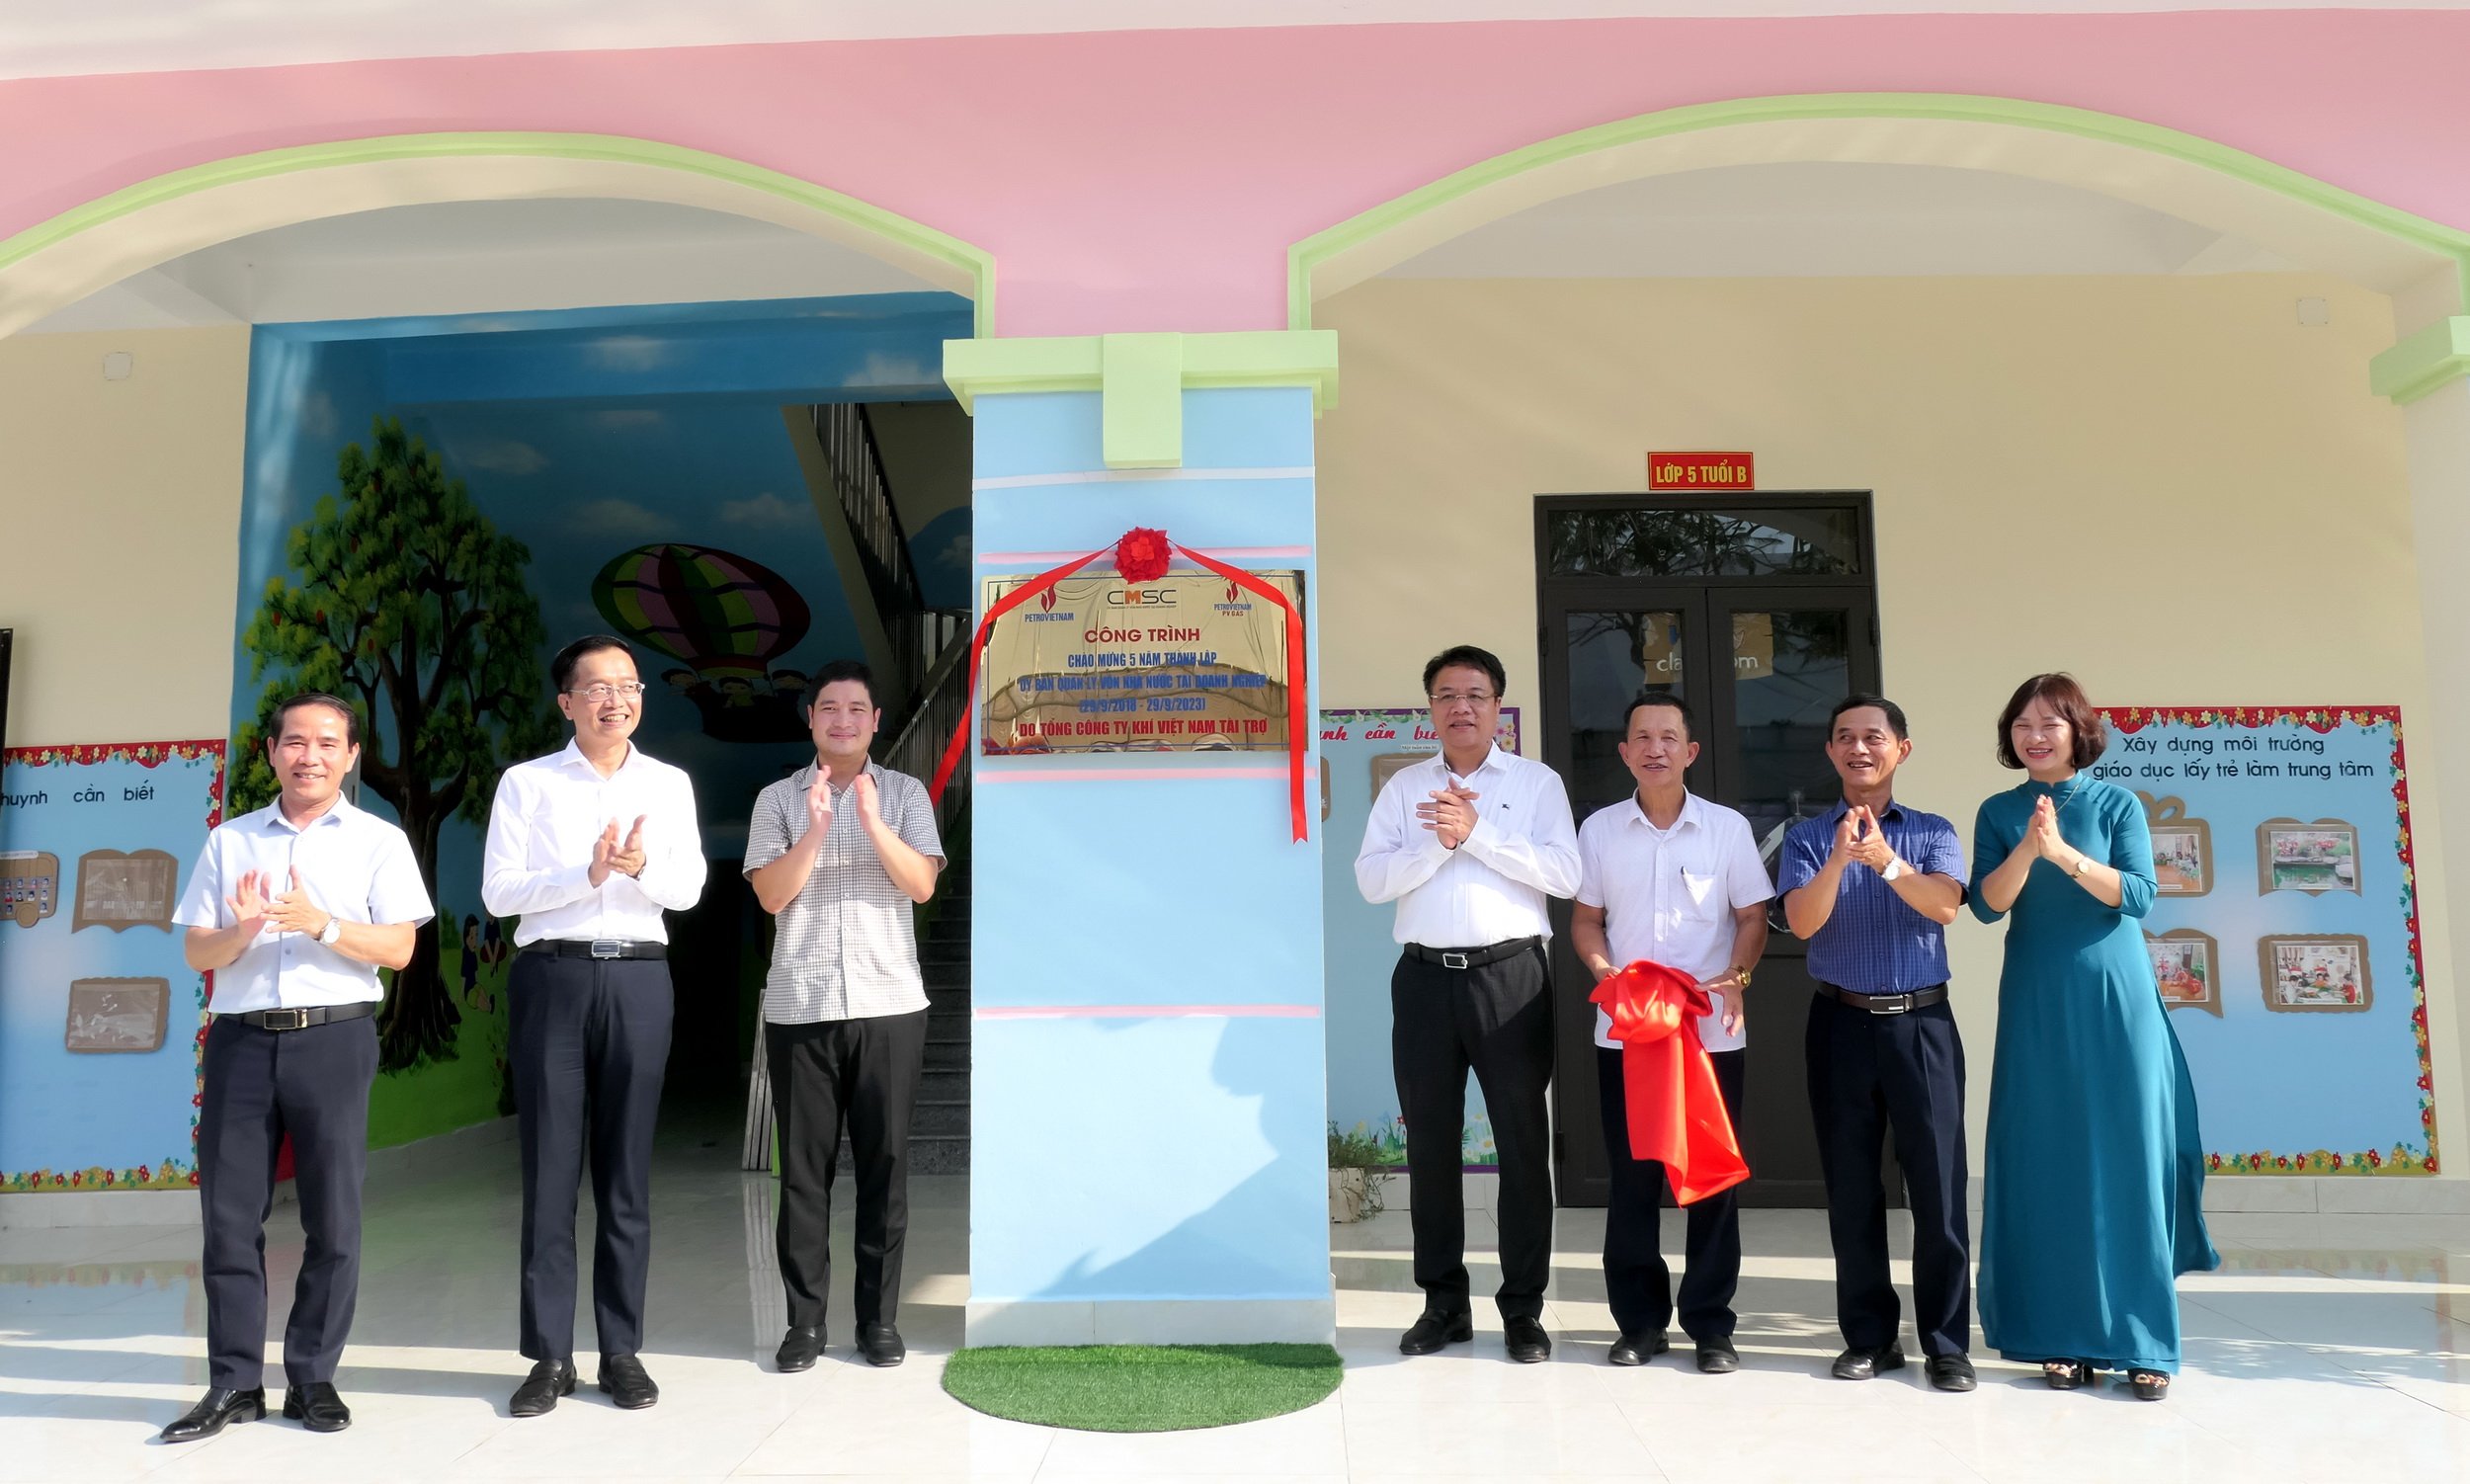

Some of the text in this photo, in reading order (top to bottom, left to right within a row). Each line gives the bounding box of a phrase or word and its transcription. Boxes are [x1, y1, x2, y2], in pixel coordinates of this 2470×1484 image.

[1656, 458, 1747, 483] LỚP 5 TUỔI B
[1108, 590, 1177, 605] CMSC
[1025, 613, 1074, 622] PETROVIETNAM
[1084, 624, 1200, 643] CÔNG TRÌNH
[1129, 654, 1136, 667] 5
[1020, 717, 1268, 737] DO TỔNG CÔNG TY KHÍ VIỆT NAM TÀI TRỢ
[1364, 722, 1396, 740] cần
[2122, 733, 2325, 757] Xây dựng môi trường
[2093, 758, 2374, 782] giáo dục lấy trẻ làm trung tâm
[0, 779, 155, 809] huynh cần biết
